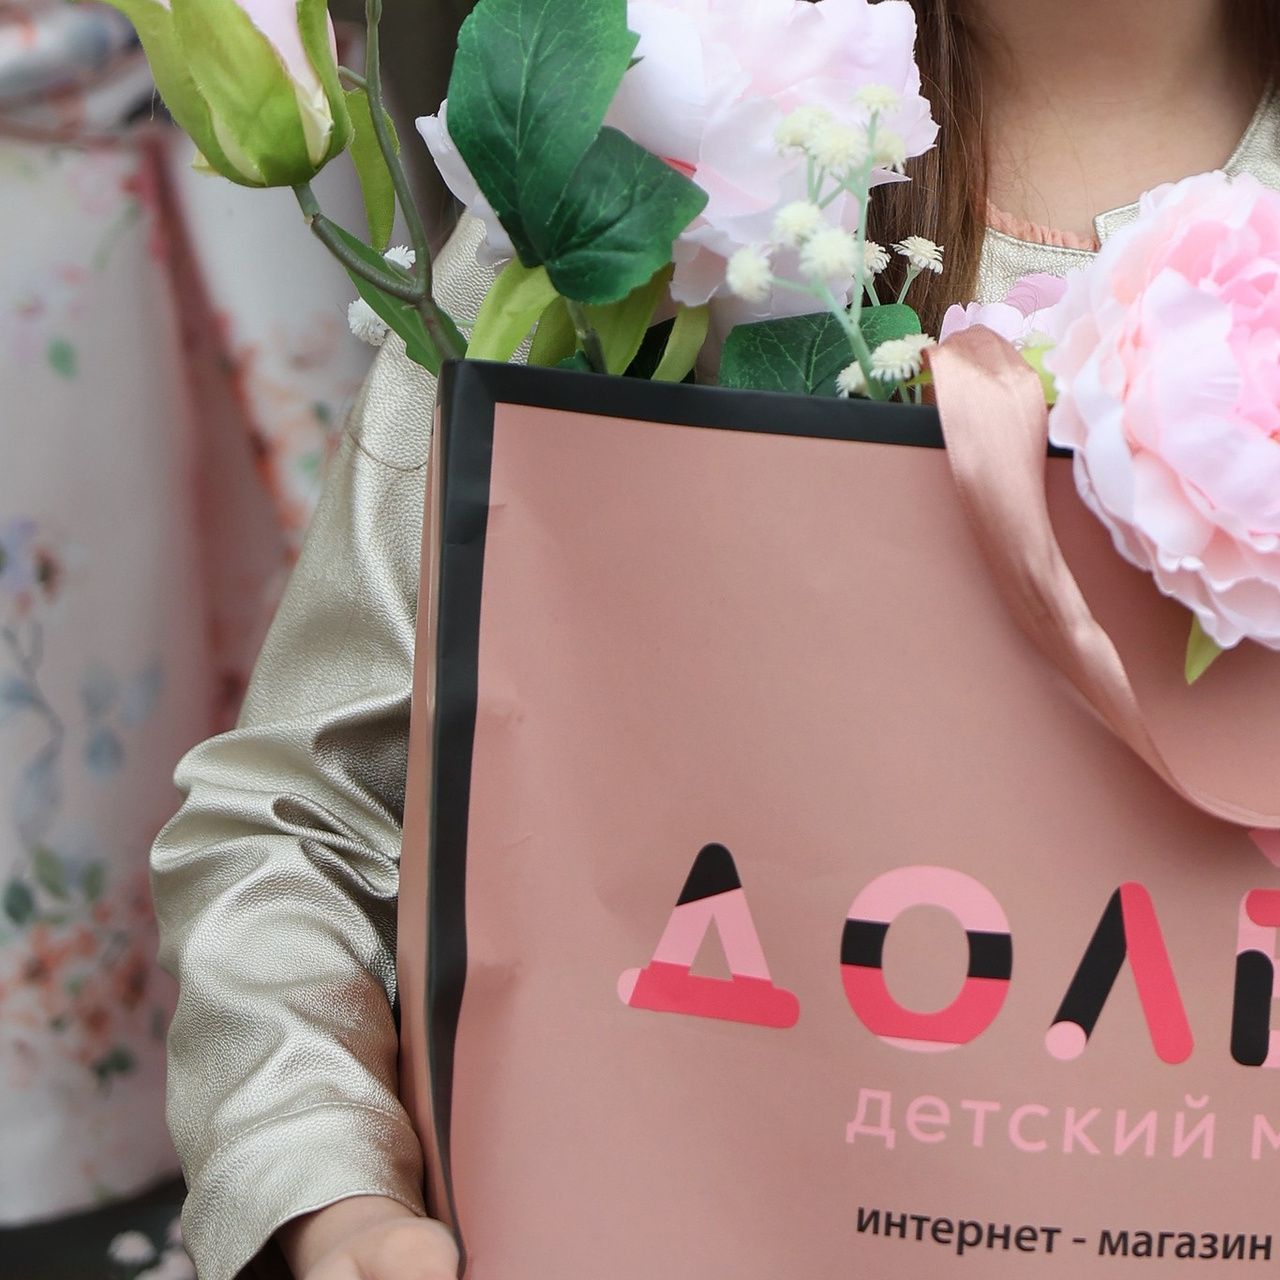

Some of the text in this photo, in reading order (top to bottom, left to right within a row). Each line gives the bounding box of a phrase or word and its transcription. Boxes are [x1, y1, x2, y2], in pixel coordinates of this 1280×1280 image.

[845, 1087, 1217, 1160] детский
[856, 1206, 1062, 1256] интернет
[1098, 1229, 1272, 1260] магазин
